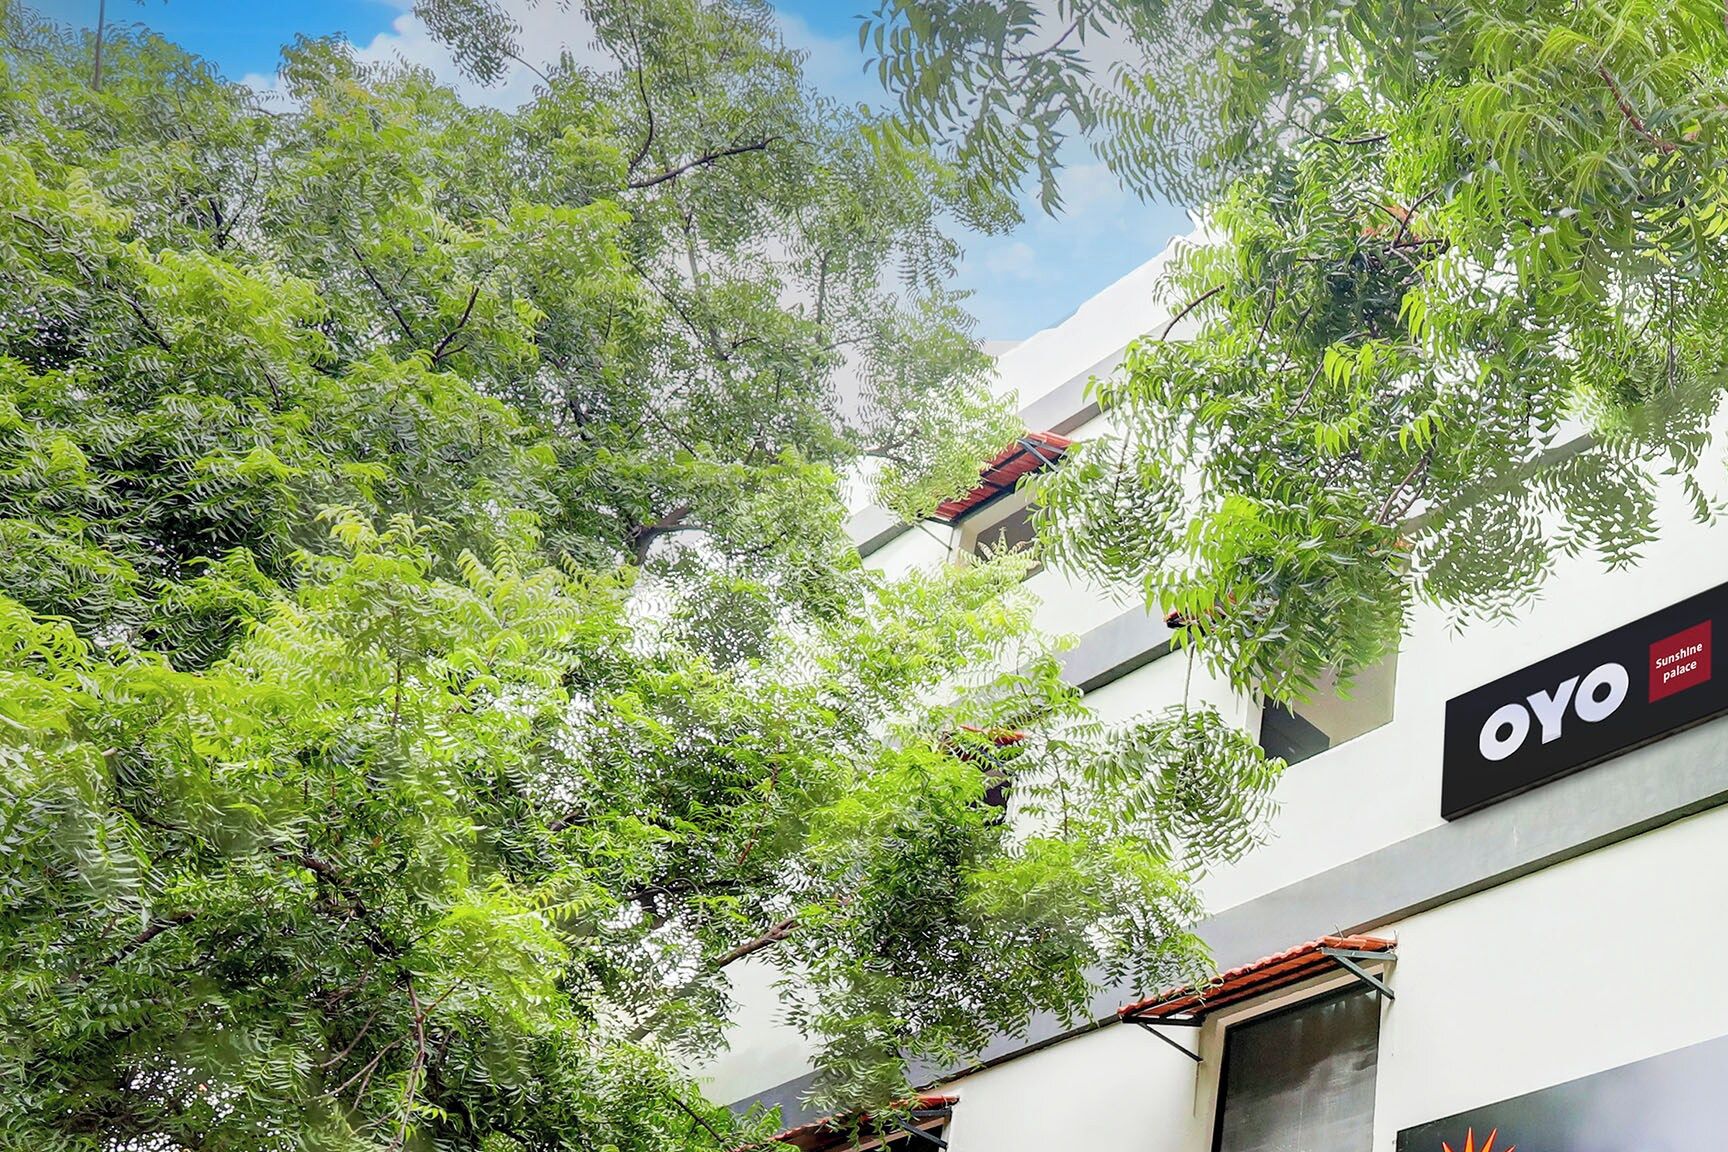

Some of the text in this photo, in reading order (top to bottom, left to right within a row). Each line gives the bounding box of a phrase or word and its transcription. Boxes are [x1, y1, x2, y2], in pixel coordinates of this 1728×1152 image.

[1655, 642, 1703, 669] Sunshine
[1663, 660, 1697, 684] palace
[1479, 662, 1630, 762] OYO
